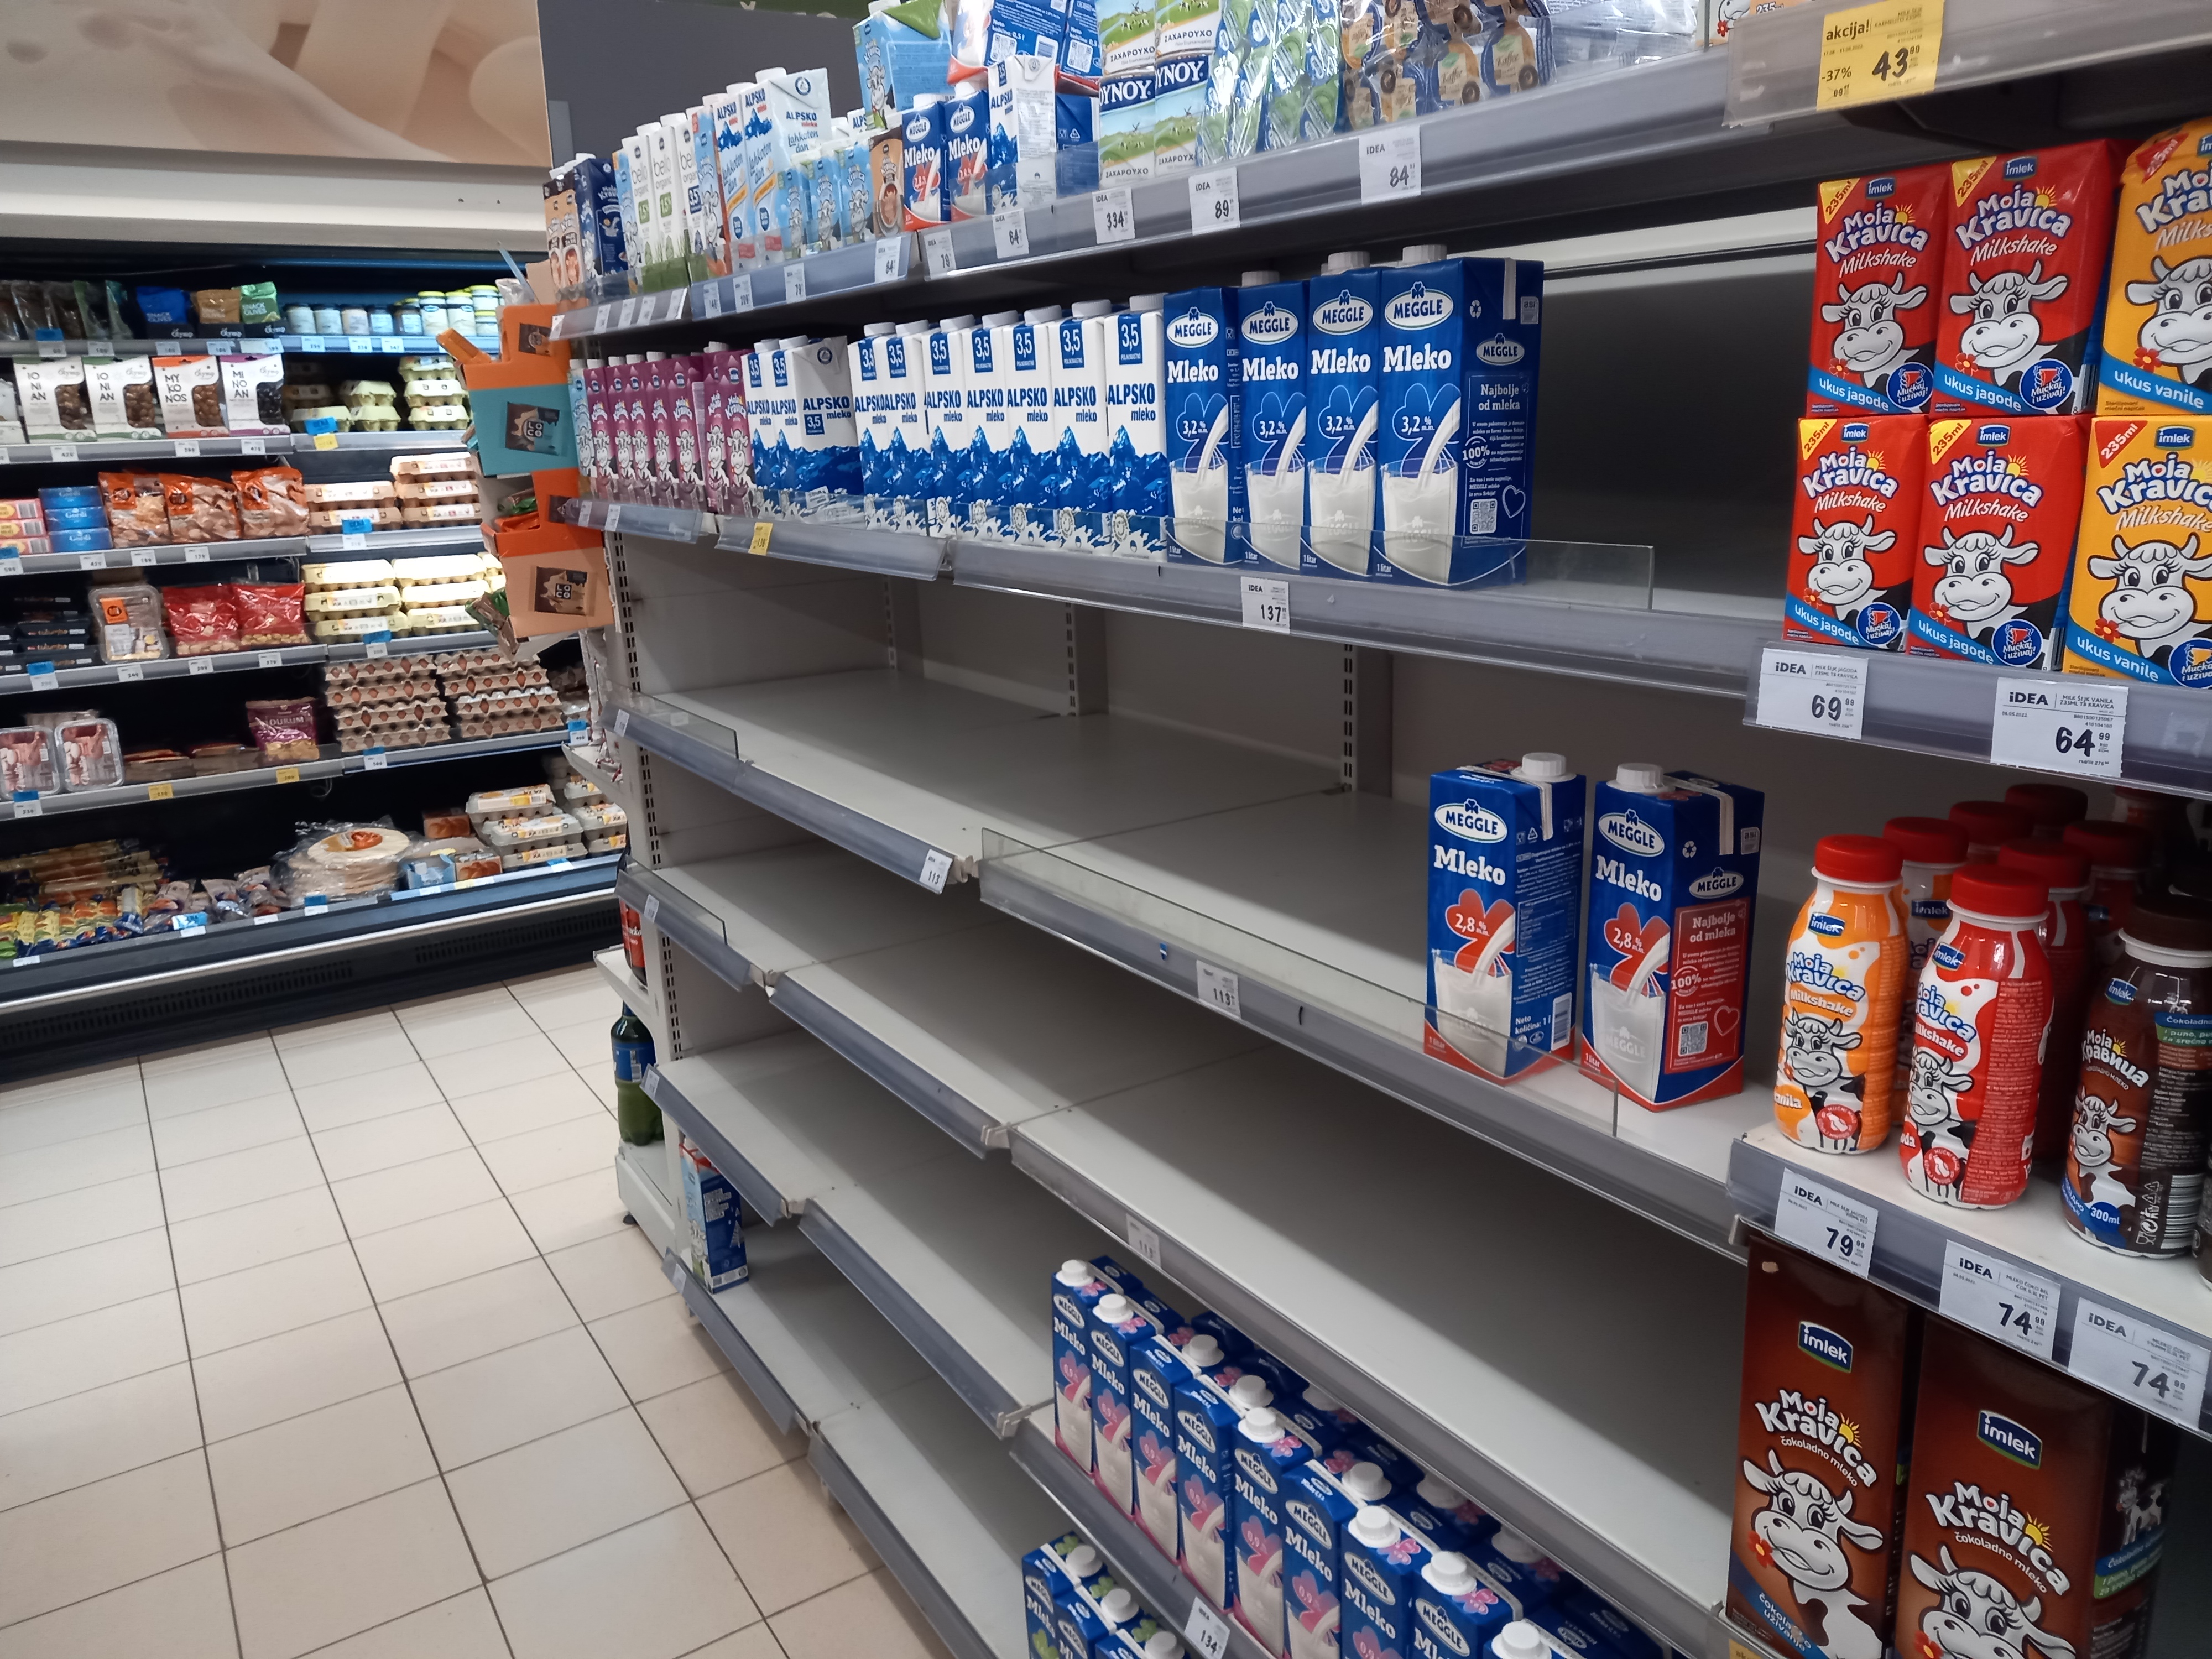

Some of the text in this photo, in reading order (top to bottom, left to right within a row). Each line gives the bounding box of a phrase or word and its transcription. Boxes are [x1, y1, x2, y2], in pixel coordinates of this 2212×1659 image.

[1826, 19, 1870, 40] akcija!
[1822, 66, 1851, 82] -37%
[1872, 47, 1909, 81] 43
[745, 88, 766, 108] ALPSKO
[786, 111, 817, 121] ALPSKO
[904, 143, 935, 169] Mleko
[948, 134, 980, 161] Mleko
[1390, 165, 1409, 187] 84
[1107, 210, 1124, 230] 334
[1215, 199, 1229, 220] 89
[1955, 207, 2071, 249] Kravica
[1825, 223, 1928, 262] Kravica
[1970, 235, 2057, 267] Milkshake
[1839, 248, 1917, 278] Milkshake
[1322, 306, 1365, 324] MEGGLE
[1394, 299, 1443, 319] MEGGLE
[1121, 323, 1139, 351] 3,5
[1175, 322, 1212, 338] MEGGLE
[1250, 317, 1290, 334] MEGGLE
[1063, 329, 1080, 355] 3,5
[1483, 346, 1518, 357] MEGGLE
[1167, 359, 1219, 383] Mleko
[1243, 356, 1298, 382] Mleko
[1311, 347, 1371, 374] Mleko
[1384, 343, 1452, 373] Mleko
[31, 392, 46, 400] AN
[100, 392, 114, 400] AN
[165, 394, 187, 403] NOS
[234, 390, 249, 398] AN
[885, 393, 916, 410] ALPSKO
[927, 390, 961, 408] ALPSKO
[967, 388, 1004, 408] ALPSKO
[1007, 387, 1047, 408] ALPSKO
[1053, 386, 1097, 407] ALPSKO
[1108, 383, 1155, 405] ALPSKO
[1481, 384, 1519, 397] Najbolje
[1819, 377, 1845, 397] ukus
[1847, 390, 1889, 411] jagode
[1944, 374, 1974, 397] ukus
[1976, 389, 2021, 411] jagode
[2114, 370, 2204, 409] ukus vanile
[771, 399, 796, 415] ALPSKO
[803, 397, 850, 410] ALPSKO
[827, 410, 851, 419] mleko
[1076, 409, 1097, 422] mleko
[1131, 408, 1156, 421] mleko
[1478, 400, 1520, 410] od mleka
[1326, 416, 1343, 434] 3,2
[1401, 416, 1421, 435] 3,2
[1803, 422, 1831, 452] 235ml
[1843, 426, 1867, 439] imlek
[1979, 429, 2007, 442] imlek
[2158, 431, 2190, 444] imlek
[1932, 421, 1963, 456] 235ml
[2100, 423, 2139, 460] 235ml
[1802, 466, 1898, 498] Kravica
[1931, 472, 2043, 507] Kravica
[1814, 492, 1886, 513] Milkshake
[1944, 499, 2029, 522] Milkshake
[2115, 504, 2212, 533] Milkshake
[1381, 564, 1391, 573] litar
[1261, 604, 1281, 622] 137
[1794, 604, 1859, 645] ukus jagode
[1918, 619, 1994, 664] ukus jagode
[2077, 636, 2158, 682] ukus vanile
[1812, 695, 1841, 721] 69
[2056, 727, 2110, 757] 64 99
[1445, 812, 1498, 836] MEGGLE
[1608, 821, 1655, 849] MEGGLE
[1434, 844, 1506, 886] Mleko
[1595, 855, 1662, 902] Mleko
[1697, 876, 1737, 893] MEGGLE
[1455, 913, 1475, 934] 2,8
[1693, 914, 1735, 930] Najbolje
[1613, 926, 1632, 950] 2,8
[1786, 961, 1866, 1003] Kravica
[1790, 990, 1854, 1017] Milkshake
[1516, 1015, 1531, 1026] Neto
[2090, 1206, 2120, 1225] 300ml
[1826, 1227, 1853, 1256] 79
[1999, 1302, 2032, 1335] 74
[1054, 1317, 1086, 1355] Mleko
[1803, 1329, 1848, 1364] imlek
[1092, 1354, 1125, 1395] Mleko
[2132, 1361, 2170, 1398] 74
[1133, 1392, 1170, 1437] Mleko
[1778, 1389, 1839, 1427] Moja
[1755, 1402, 1877, 1488] Kravica
[1984, 1416, 2037, 1460] imlek
[1178, 1435, 1216, 1484] Mleko
[1235, 1474, 1277, 1525] Mleko
[1954, 1482, 2026, 1527] Moja
[1286, 1526, 1332, 1582] Mleko
[1926, 1494, 2070, 1595] Kravica
[1344, 1579, 1396, 1639] Mleko
